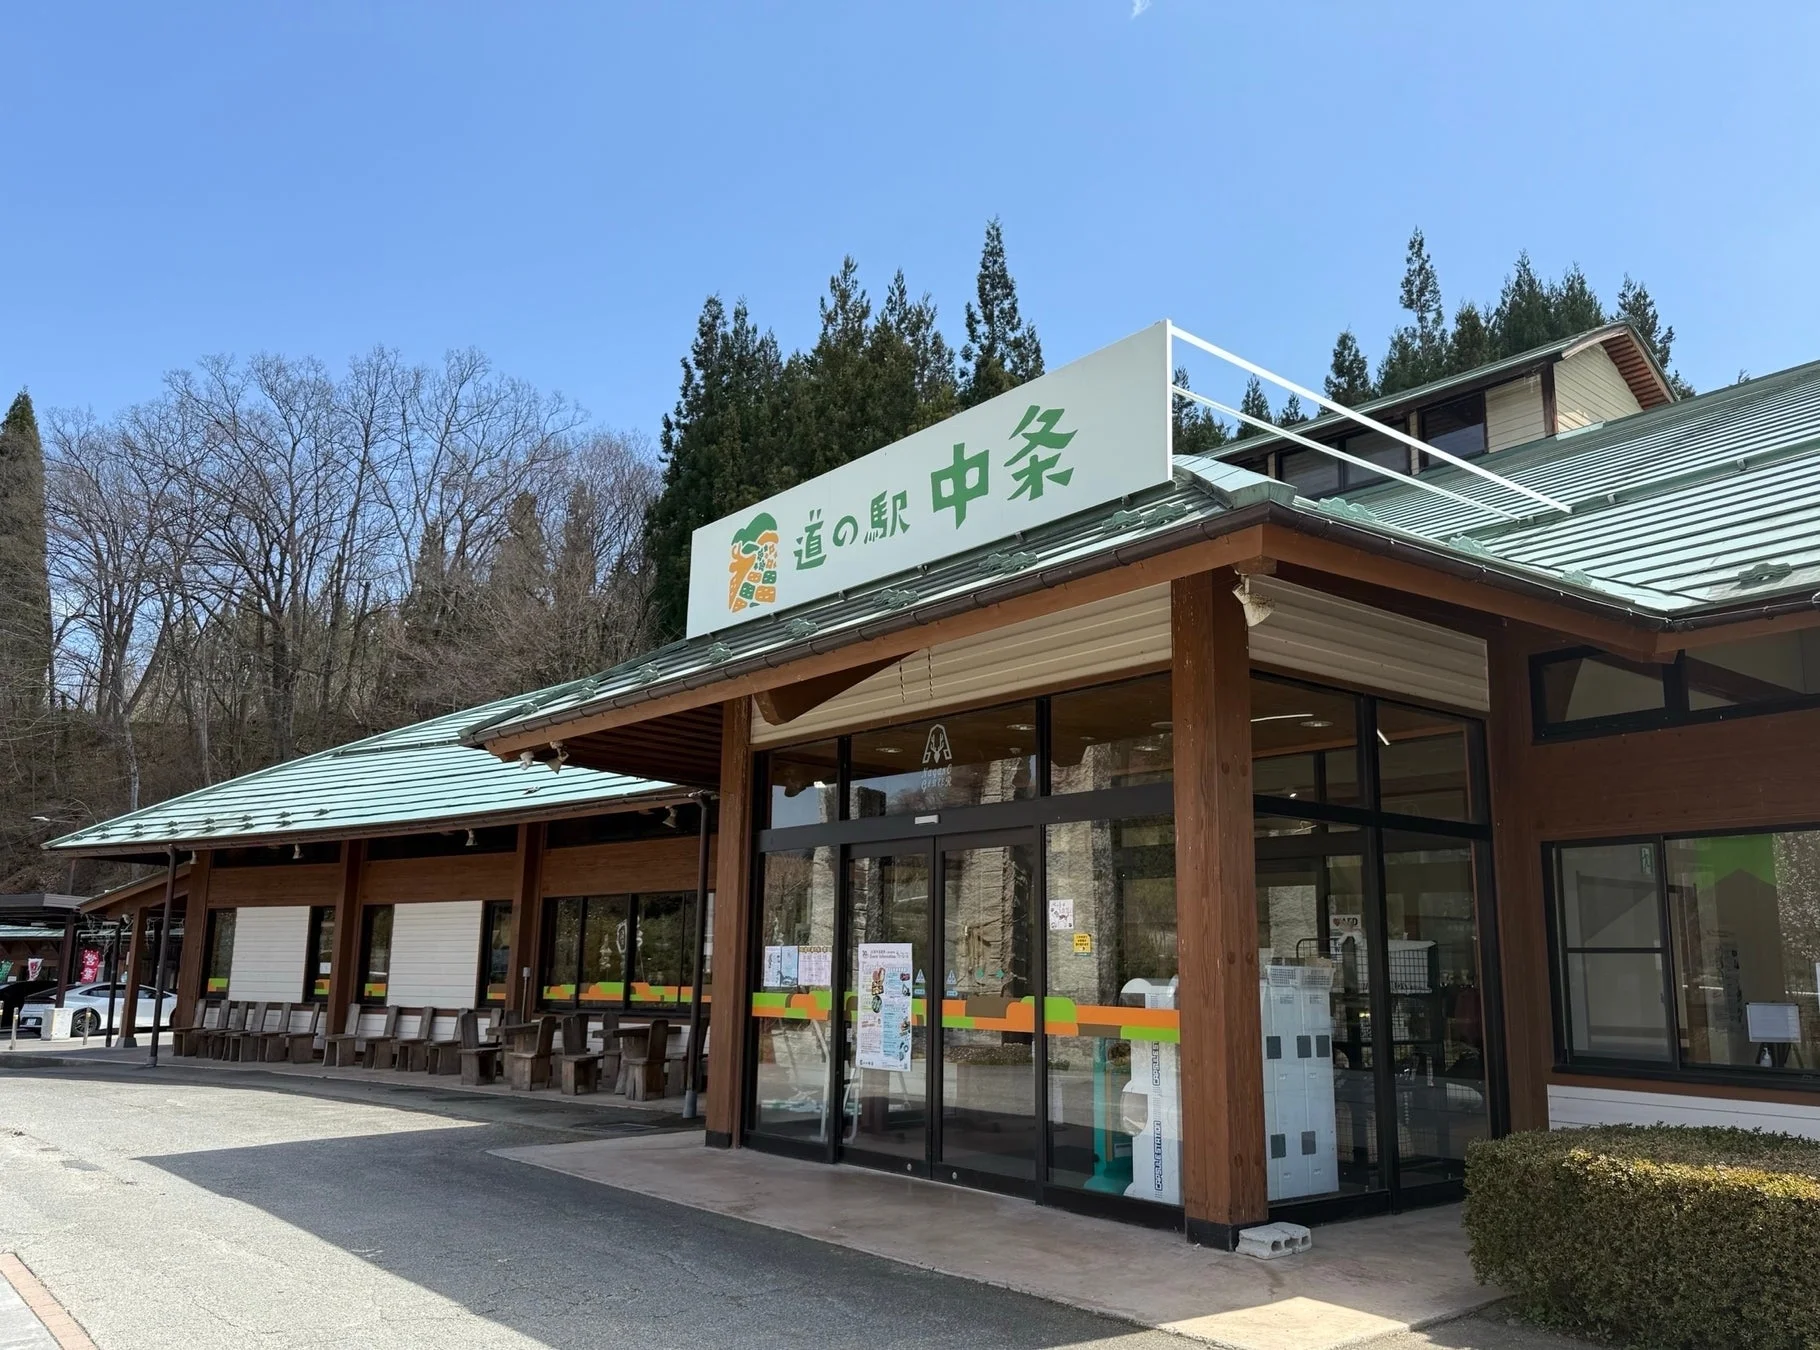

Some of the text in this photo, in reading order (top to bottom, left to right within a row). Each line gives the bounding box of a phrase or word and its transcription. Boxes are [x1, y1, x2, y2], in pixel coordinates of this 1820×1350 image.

[793, 405, 1078, 571] 道の駅 中条
[1152, 1050, 1160, 1086] CAPSULE
[1153, 1120, 1162, 1191] CAPSULE STATION
